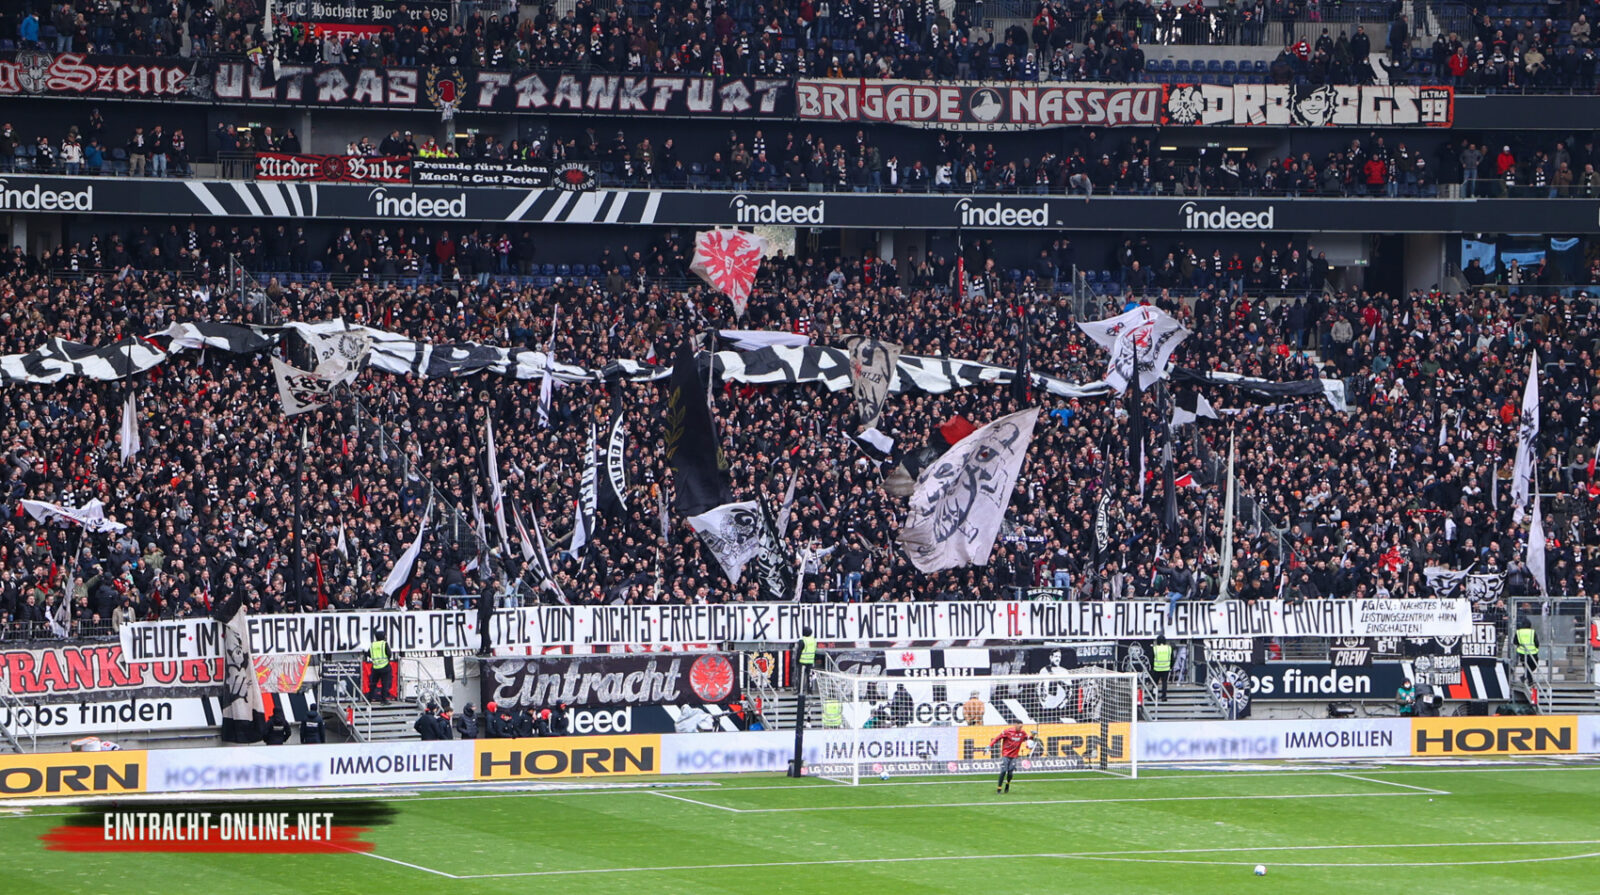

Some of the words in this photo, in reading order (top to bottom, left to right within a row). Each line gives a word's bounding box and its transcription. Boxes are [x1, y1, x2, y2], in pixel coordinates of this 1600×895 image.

[312, 3, 368, 20] Höchster
[372, 5, 422, 21] Boer
[48, 53, 187, 94] Szene
[215, 64, 418, 103] ULTRAS
[476, 72, 789, 113] FRANKFURT
[798, 84, 963, 121] BRIGADE
[1010, 86, 1162, 126] NASSAU
[1421, 99, 1447, 122] 99
[347, 157, 405, 179] Bube
[413, 161, 471, 171] Freunde
[474, 162, 503, 172] fürs
[506, 163, 548, 174] Leben
[472, 174, 499, 184] Gut
[502, 175, 541, 185] Peter
[0, 183, 93, 211] indeed
[375, 186, 466, 217] indeed
[736, 195, 824, 224] indeed
[961, 202, 1049, 227] indeed
[1186, 206, 1273, 229] indeed
[1361, 612, 1434, 623] LEISTUNGSZENTRUM
[1438, 612, 1457, 622] HIRN
[1441, 601, 1455, 610] MAL
[131, 625, 187, 659] HEUTE
[196, 622, 220, 656] IM
[247, 614, 423, 653] EDERWALD-KINO:
[429, 613, 467, 648] DER
[493, 610, 530, 645] TEIL
[538, 607, 575, 643] VON
[659, 605, 748, 642] ERREICHT
[752, 605, 771, 640] &
[778, 602, 848, 639] FRÜHER
[857, 604, 898, 638] WEG
[907, 604, 938, 638] MIT
[948, 603, 997, 637] ANDY
[1114, 602, 1165, 636] ALLES
[1176, 602, 1217, 635] GUTE
[1226, 602, 1274, 634] AUCH
[1283, 600, 1355, 634] PRIVAT!
[1204, 650, 1253, 662] VERBOT
[1335, 651, 1368, 666] CREW
[1462, 644, 1496, 656] GEBIET
[491, 658, 681, 709] Eintracht
[1283, 669, 1370, 694] finden
[79, 697, 172, 724] finden
[567, 706, 632, 734] deed
[826, 740, 938, 760] IMMOBILIEN
[1285, 730, 1393, 749] IMMOBILIEN
[1416, 727, 1571, 753] HORN
[330, 754, 453, 776] IMMOBILIEN
[480, 747, 654, 776] HORN
[0, 763, 139, 794] ORN
